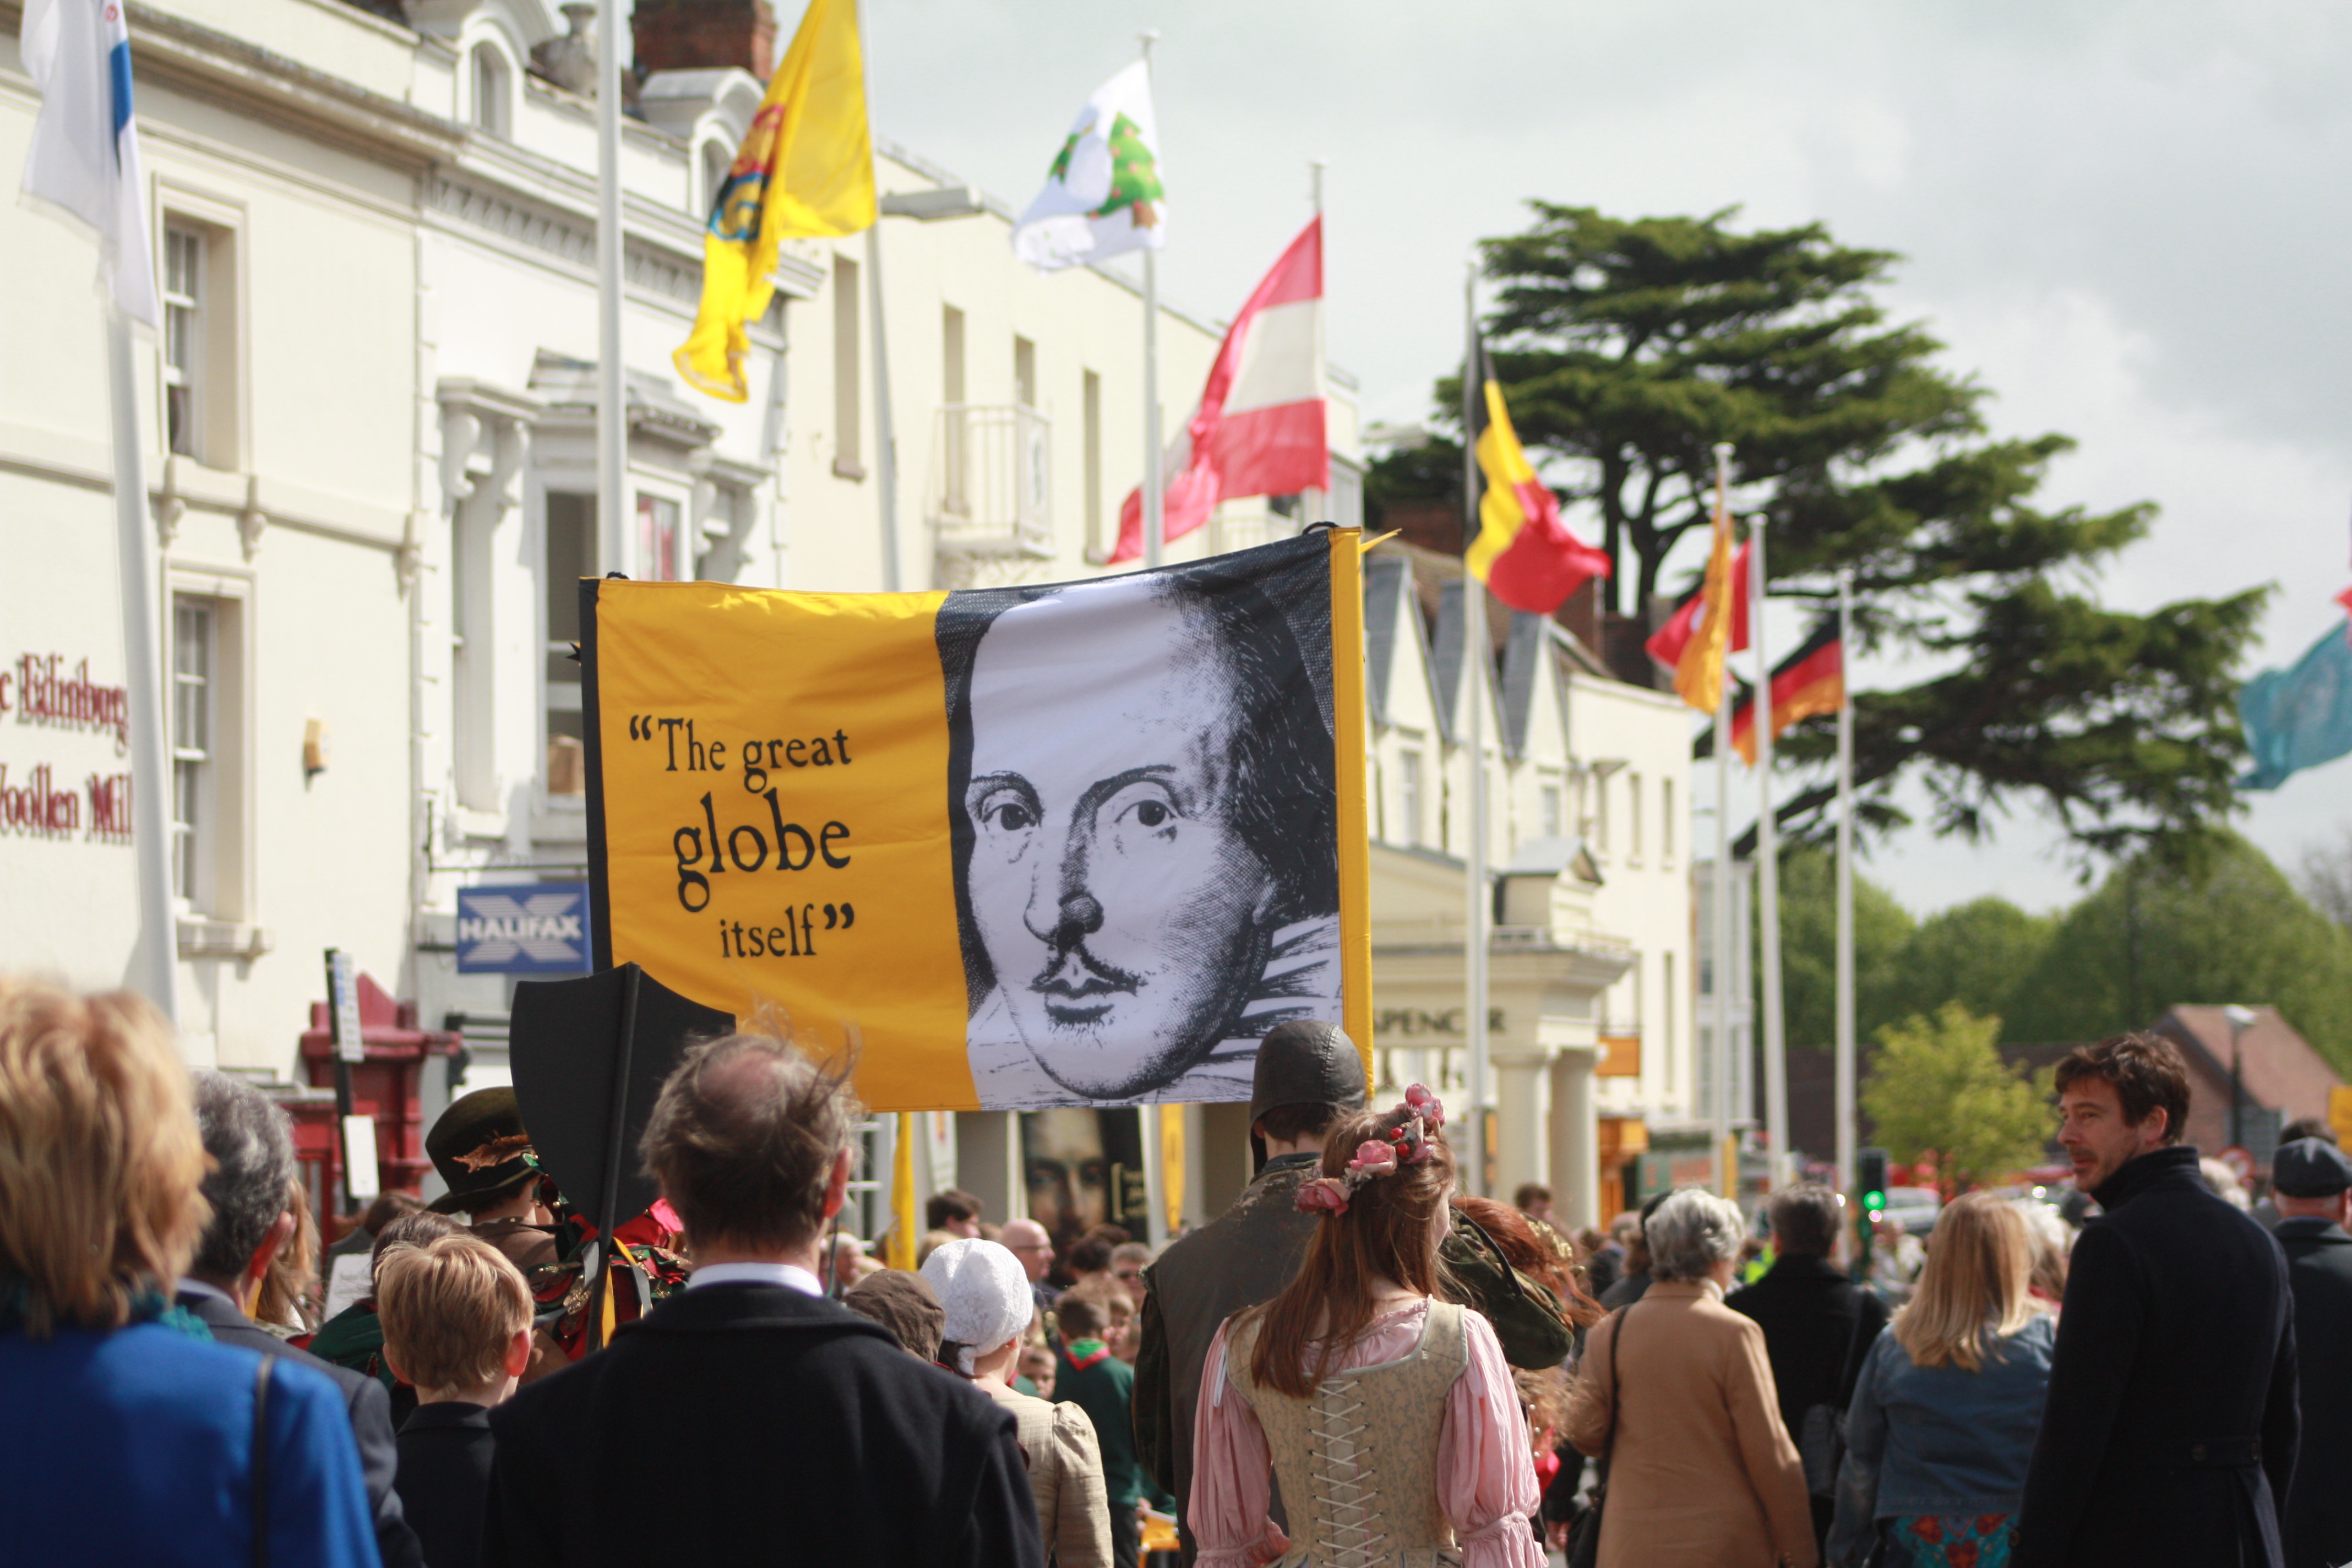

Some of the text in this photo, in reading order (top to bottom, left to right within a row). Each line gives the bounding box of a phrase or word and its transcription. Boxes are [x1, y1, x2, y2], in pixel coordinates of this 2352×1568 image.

[22, 652, 130, 747] Edinburg
[743, 729, 852, 793] great
[0, 763, 133, 833] oollen Mil
[673, 787, 851, 912] globe
[459, 914, 583, 941] HALIFAX
[1373, 1008, 1506, 1036] PENCR
